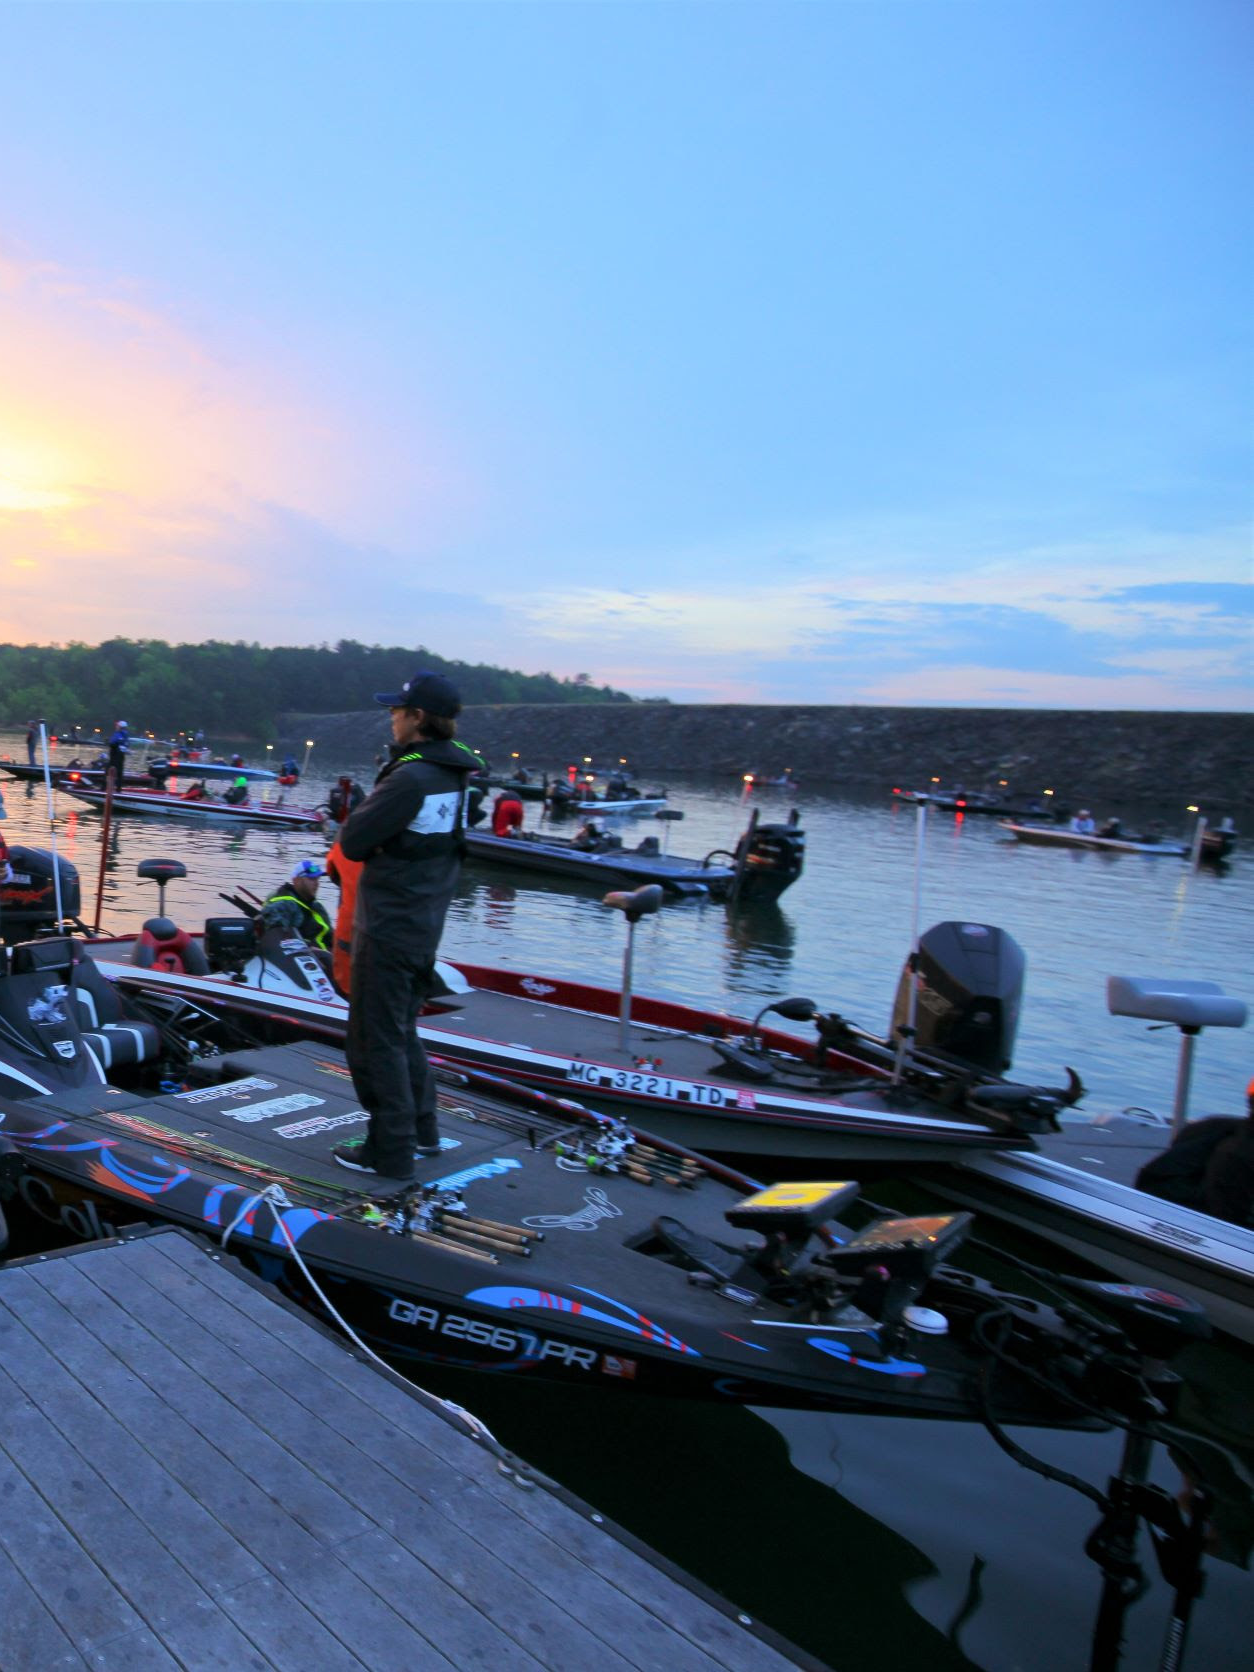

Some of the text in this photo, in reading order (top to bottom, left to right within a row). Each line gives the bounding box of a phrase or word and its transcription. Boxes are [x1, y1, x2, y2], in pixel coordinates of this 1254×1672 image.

[615, 1072, 673, 1098] 3221
[692, 1085, 723, 1105] TD
[388, 1299, 440, 1331] GA
[441, 1314, 538, 1356] 2567
[539, 1339, 598, 1371] PR
